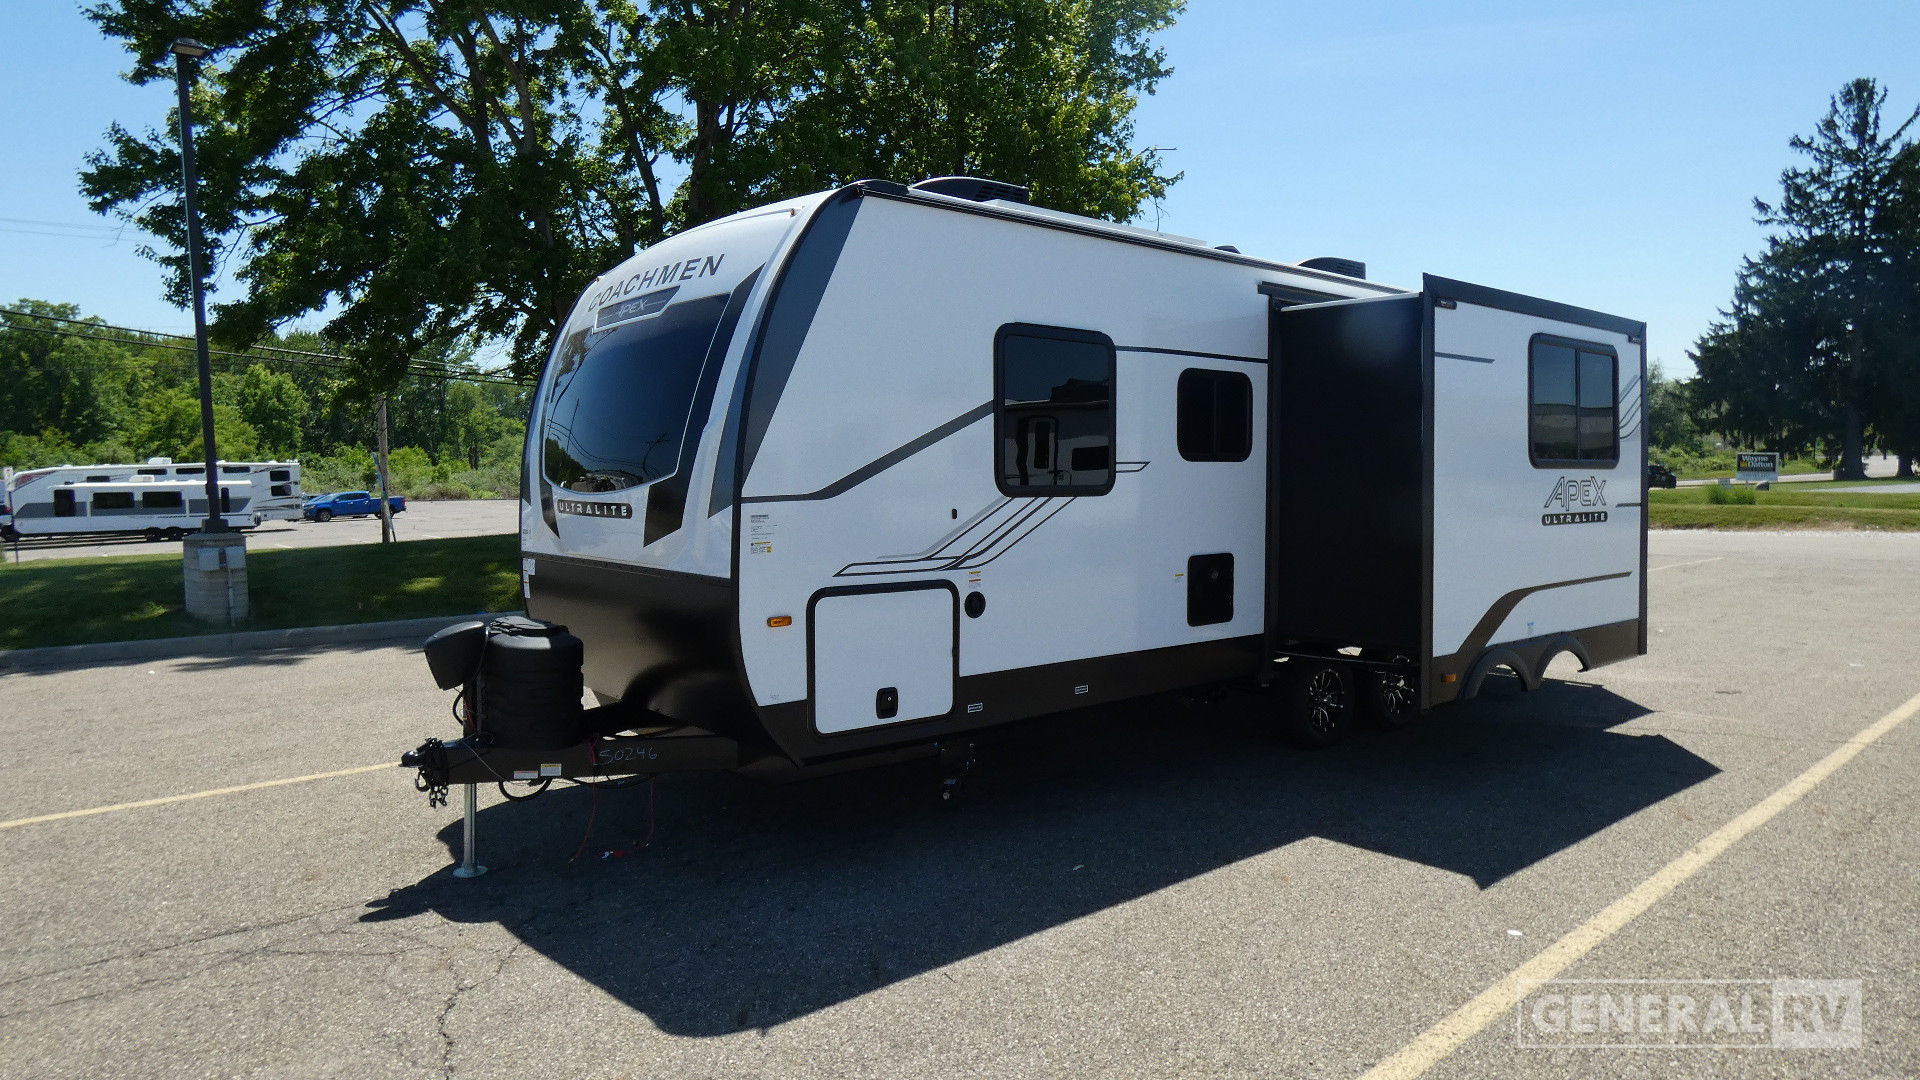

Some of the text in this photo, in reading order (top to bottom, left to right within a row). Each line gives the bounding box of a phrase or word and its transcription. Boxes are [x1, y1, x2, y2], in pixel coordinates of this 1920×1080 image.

[588, 253, 725, 313] COACHMEN
[1741, 454, 1769, 462] Wayne
[1544, 476, 1607, 512] APEX
[559, 501, 628, 517] ULTRALITE
[1544, 513, 1606, 524] ULTRALITE
